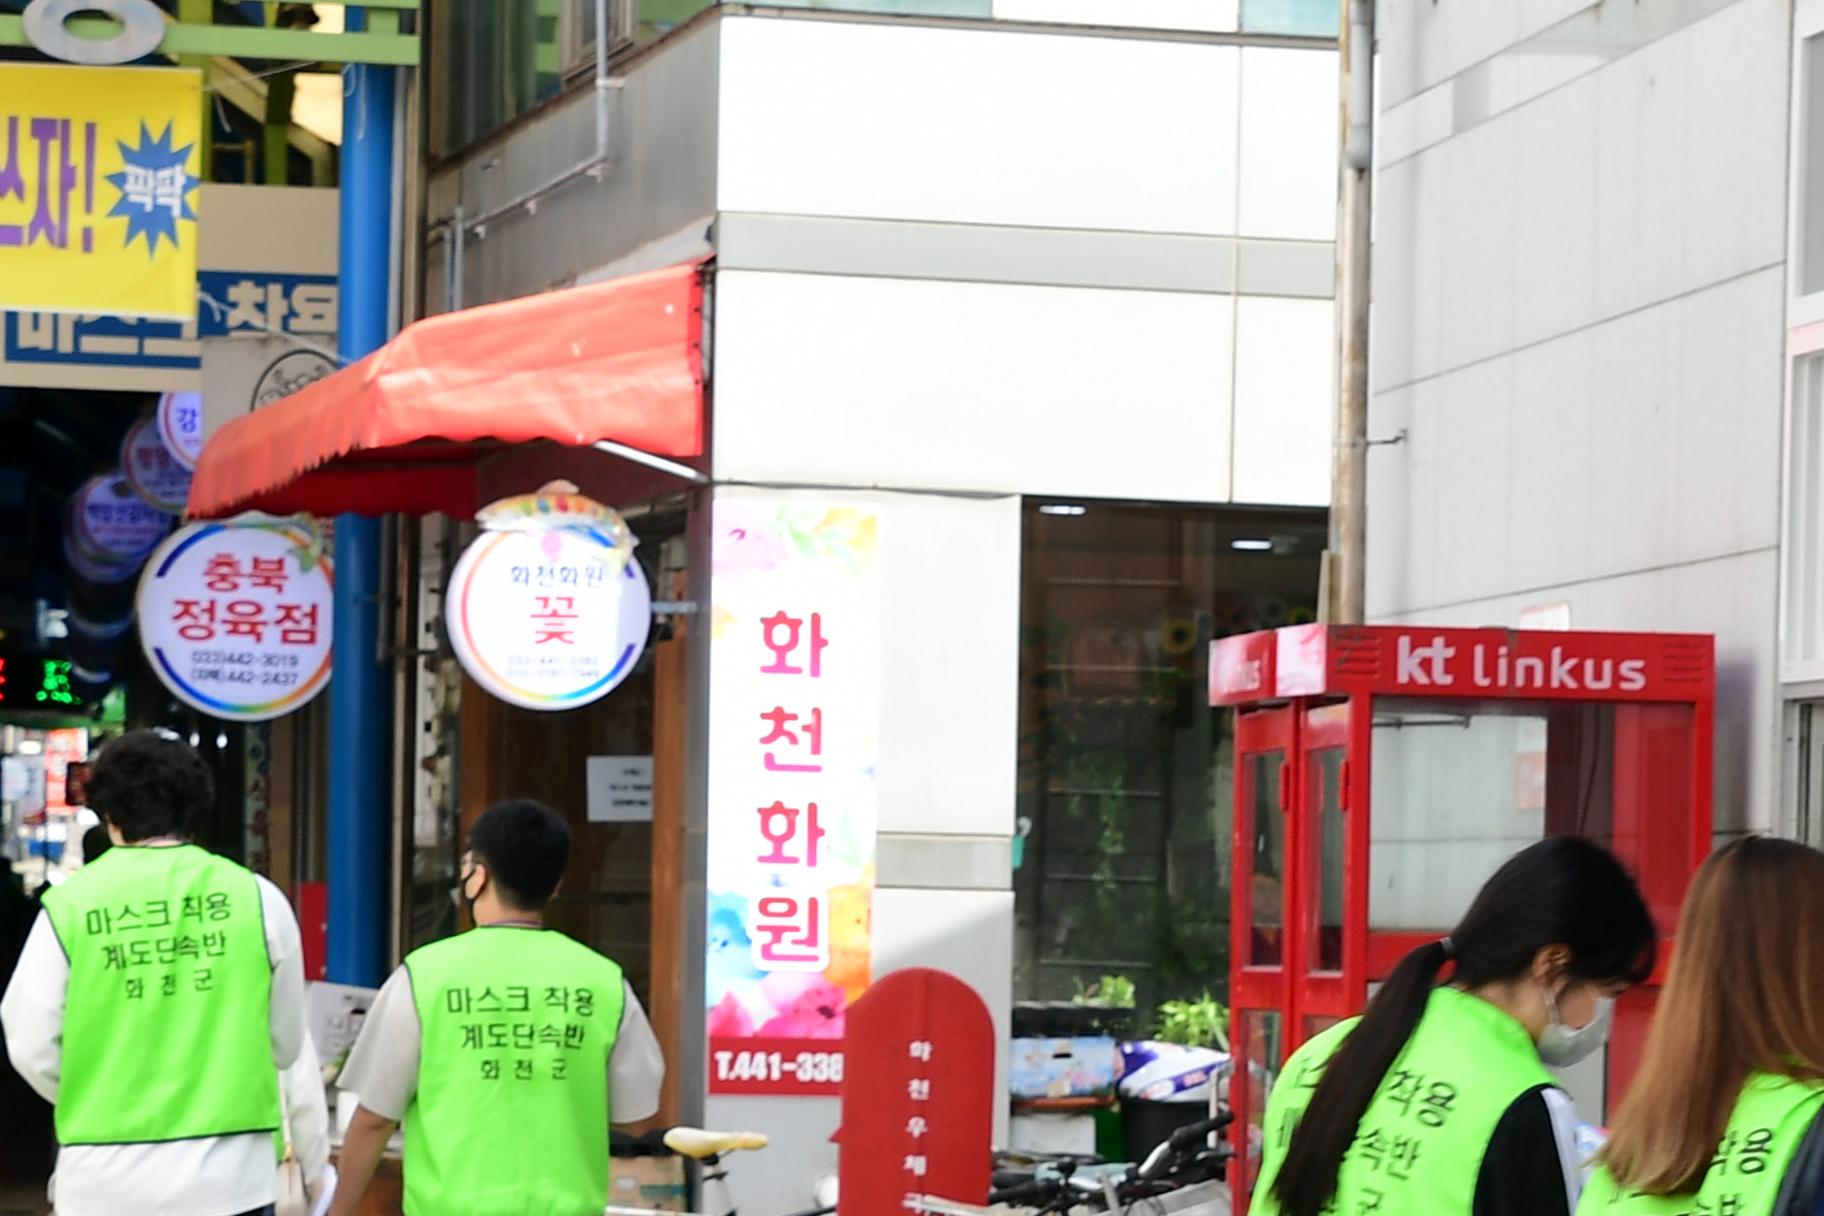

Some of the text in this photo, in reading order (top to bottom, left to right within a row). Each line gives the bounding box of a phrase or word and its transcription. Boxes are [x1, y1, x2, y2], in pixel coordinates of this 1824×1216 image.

[203, 554, 288, 593] 충북
[171, 599, 318, 645] 정육점
[530, 597, 579, 645] 꽃
[1396, 635, 1647, 690] kt linkus
[756, 610, 829, 962] 화천화원
[86, 901, 171, 935] 마스크
[102, 930, 226, 970] 계도단속반
[446, 986, 594, 1017] 마스크 착용
[459, 1023, 586, 1050] 계도단속반
